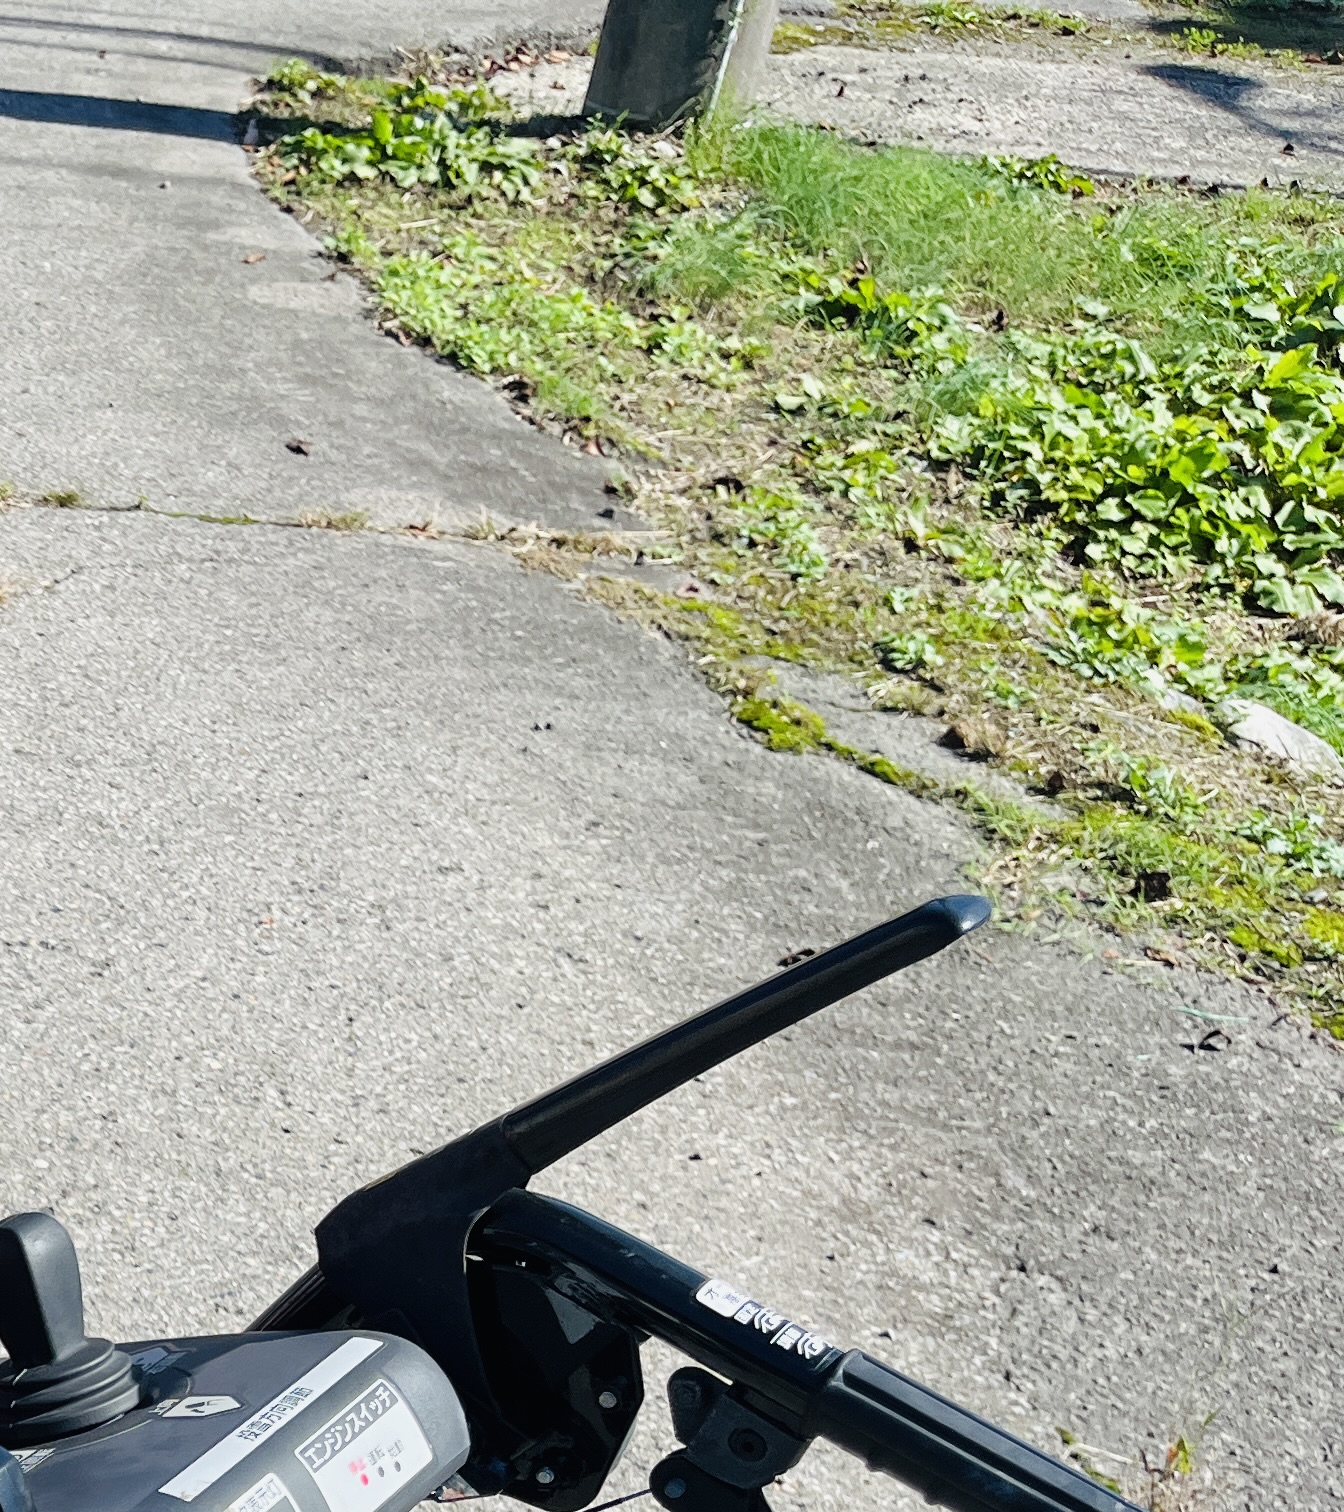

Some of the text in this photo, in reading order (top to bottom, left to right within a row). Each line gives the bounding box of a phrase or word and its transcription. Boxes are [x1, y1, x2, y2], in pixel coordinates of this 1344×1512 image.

[236, 1386, 314, 1442] 投雪方向調節
[304, 1386, 393, 1469] エンジンスイッチ
